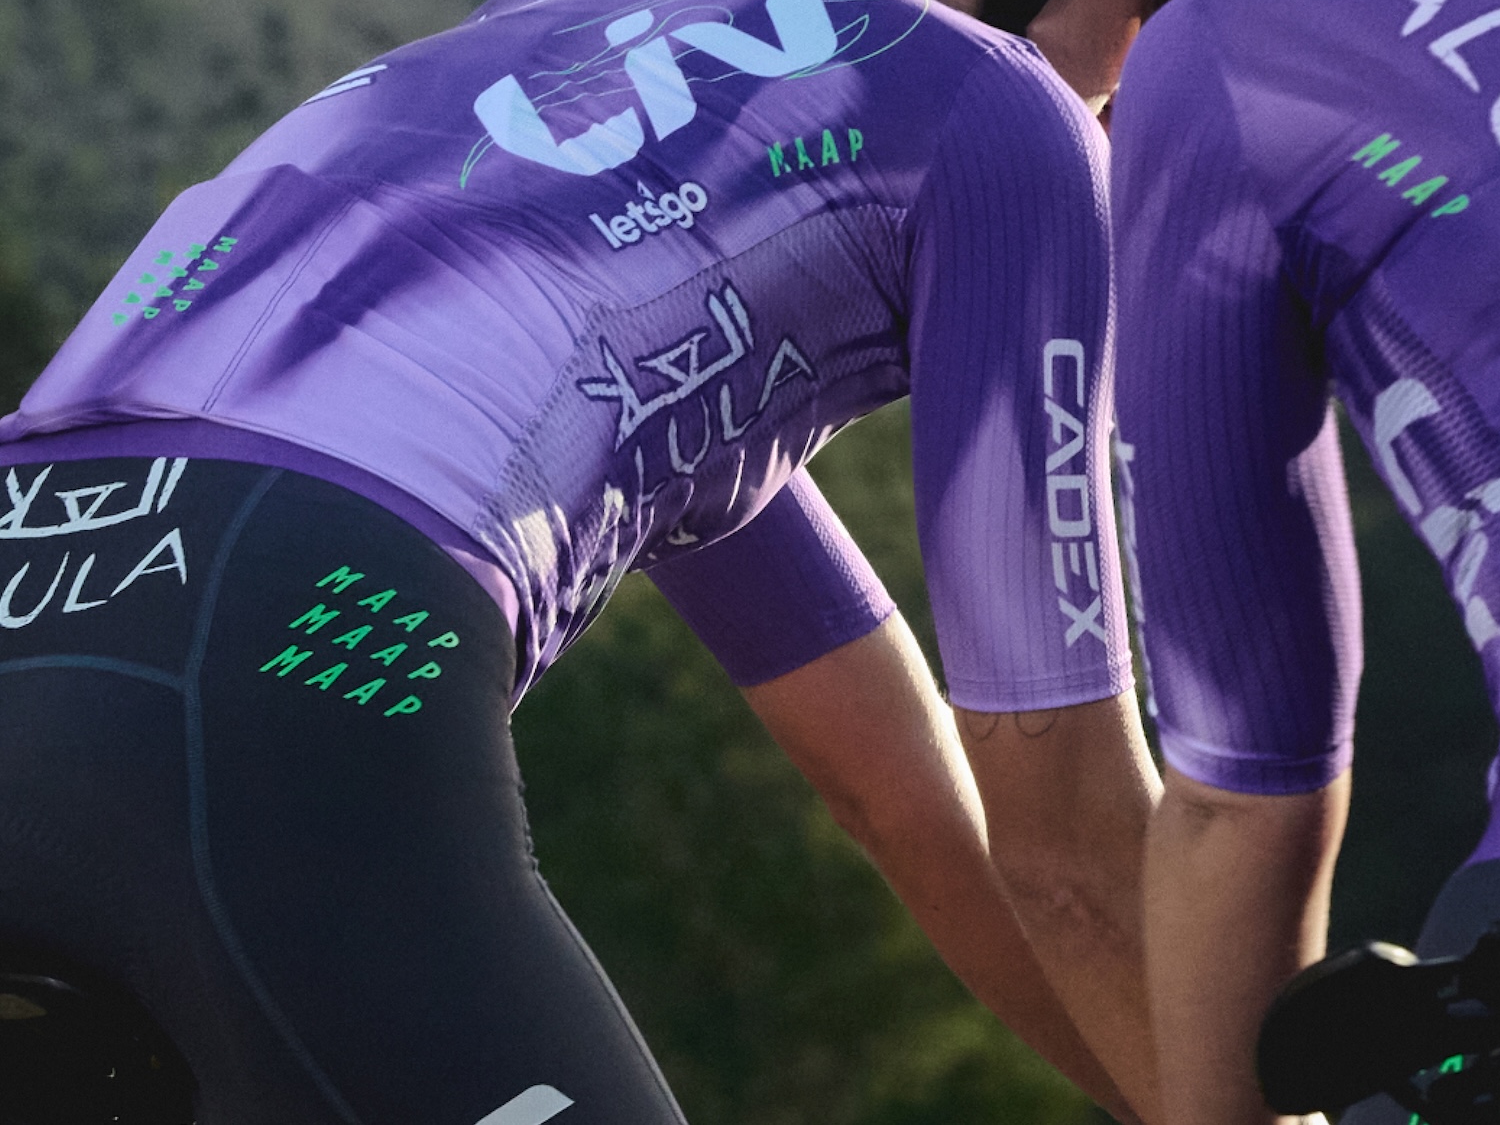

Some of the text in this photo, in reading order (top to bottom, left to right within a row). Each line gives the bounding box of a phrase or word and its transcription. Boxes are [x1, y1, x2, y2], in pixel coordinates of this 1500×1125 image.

[767, 128, 864, 177] MAAP
[1351, 132, 1470, 218] MAAP
[1043, 338, 1108, 649] CADEX
[0, 527, 188, 629] ULA
[315, 565, 461, 651] MAAP
[258, 644, 424, 718] MAAP
[288, 603, 443, 682] MAAP
